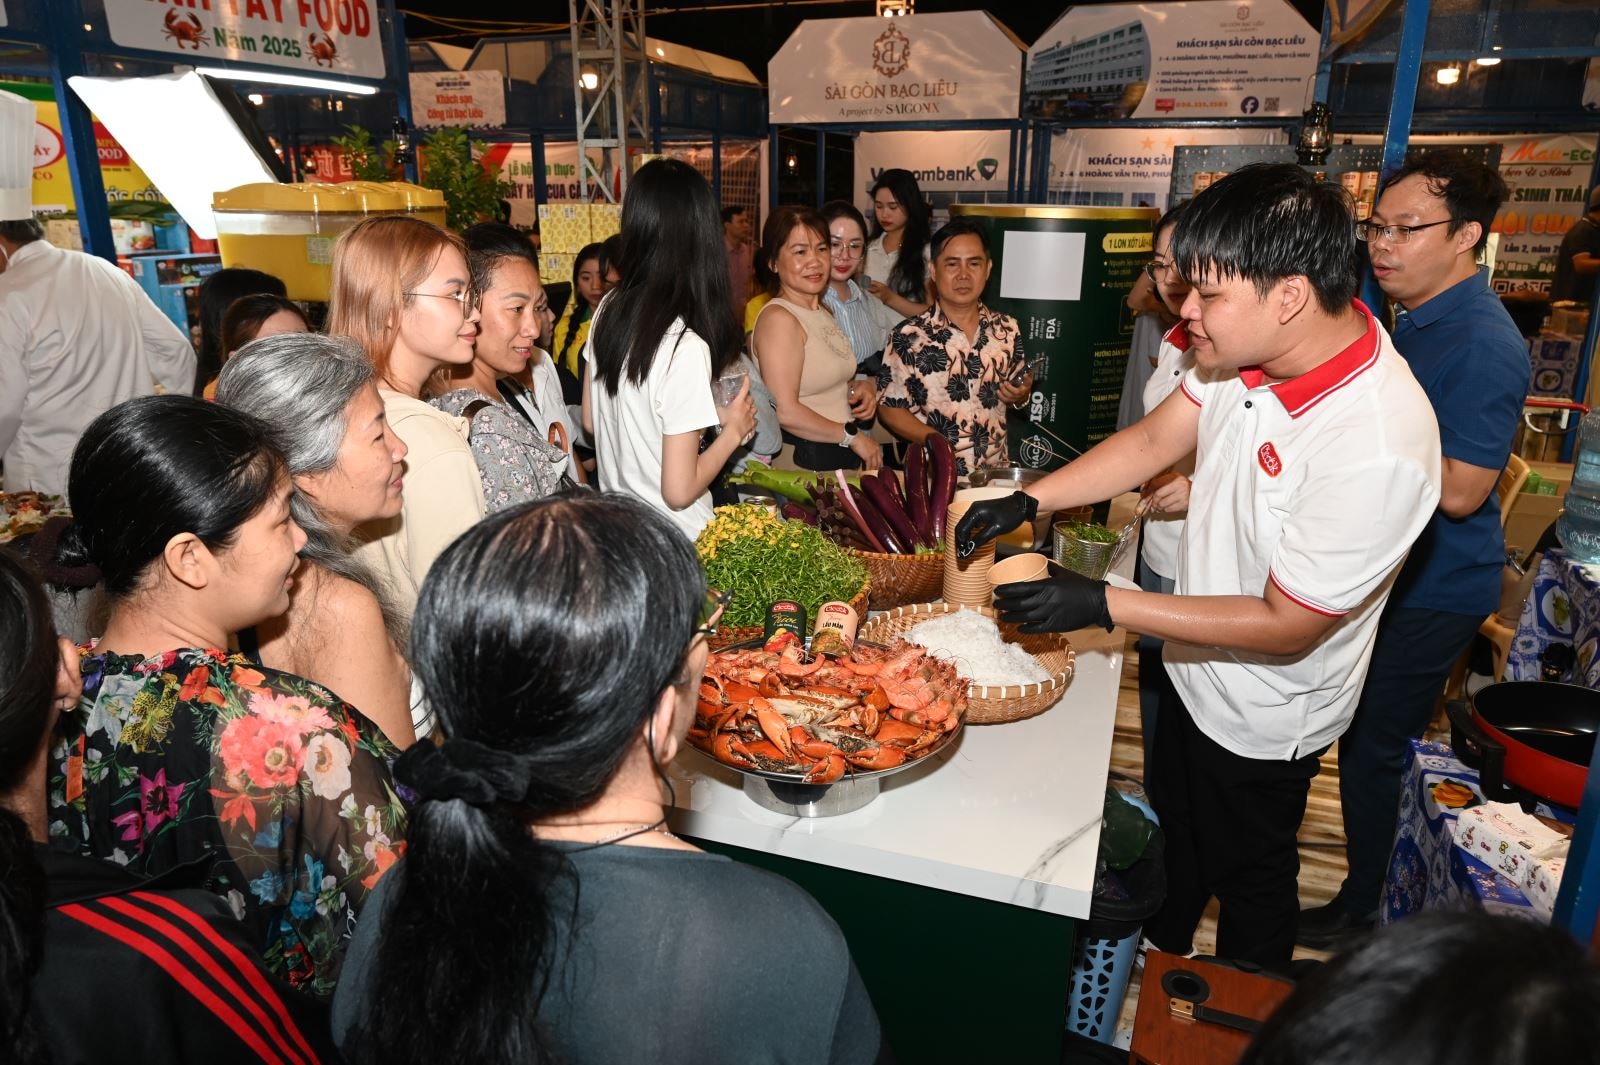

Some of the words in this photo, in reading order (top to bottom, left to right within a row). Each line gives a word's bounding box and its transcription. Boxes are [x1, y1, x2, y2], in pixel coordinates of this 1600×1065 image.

[297, 0, 370, 38] FOOD
[213, 26, 257, 52] Năm
[261, 34, 302, 58] 2025
[1176, 38, 1207, 48] KHÁCH
[1209, 40, 1226, 49] SẠN
[1228, 37, 1242, 47] SÀI
[1244, 36, 1263, 46] GÒN
[1265, 38, 1282, 47] BẠC
[825, 83, 847, 100] SÀI
[850, 82, 886, 99] GÒN
[890, 83, 920, 99] BẠC
[924, 79, 957, 97] LIÊU
[846, 107, 872, 118] project
[97, 147, 123, 160] OOD
[1088, 153, 1127, 165] KHÁCH
[1129, 157, 1151, 168] SẠN
[1153, 154, 1172, 165] SÀI
[521, 161, 533, 179] hộ
[1085, 169, 1113, 178] HOÀNG
[1114, 169, 1130, 177] VĂN
[546, 183, 567, 199] CUA
[1514, 188, 1551, 202] SINH
[1114, 239, 1127, 249] LON
[1046, 318, 1057, 339] FDA
[1030, 391, 1044, 422] ISO
[1031, 434, 1041, 469] HACCP
